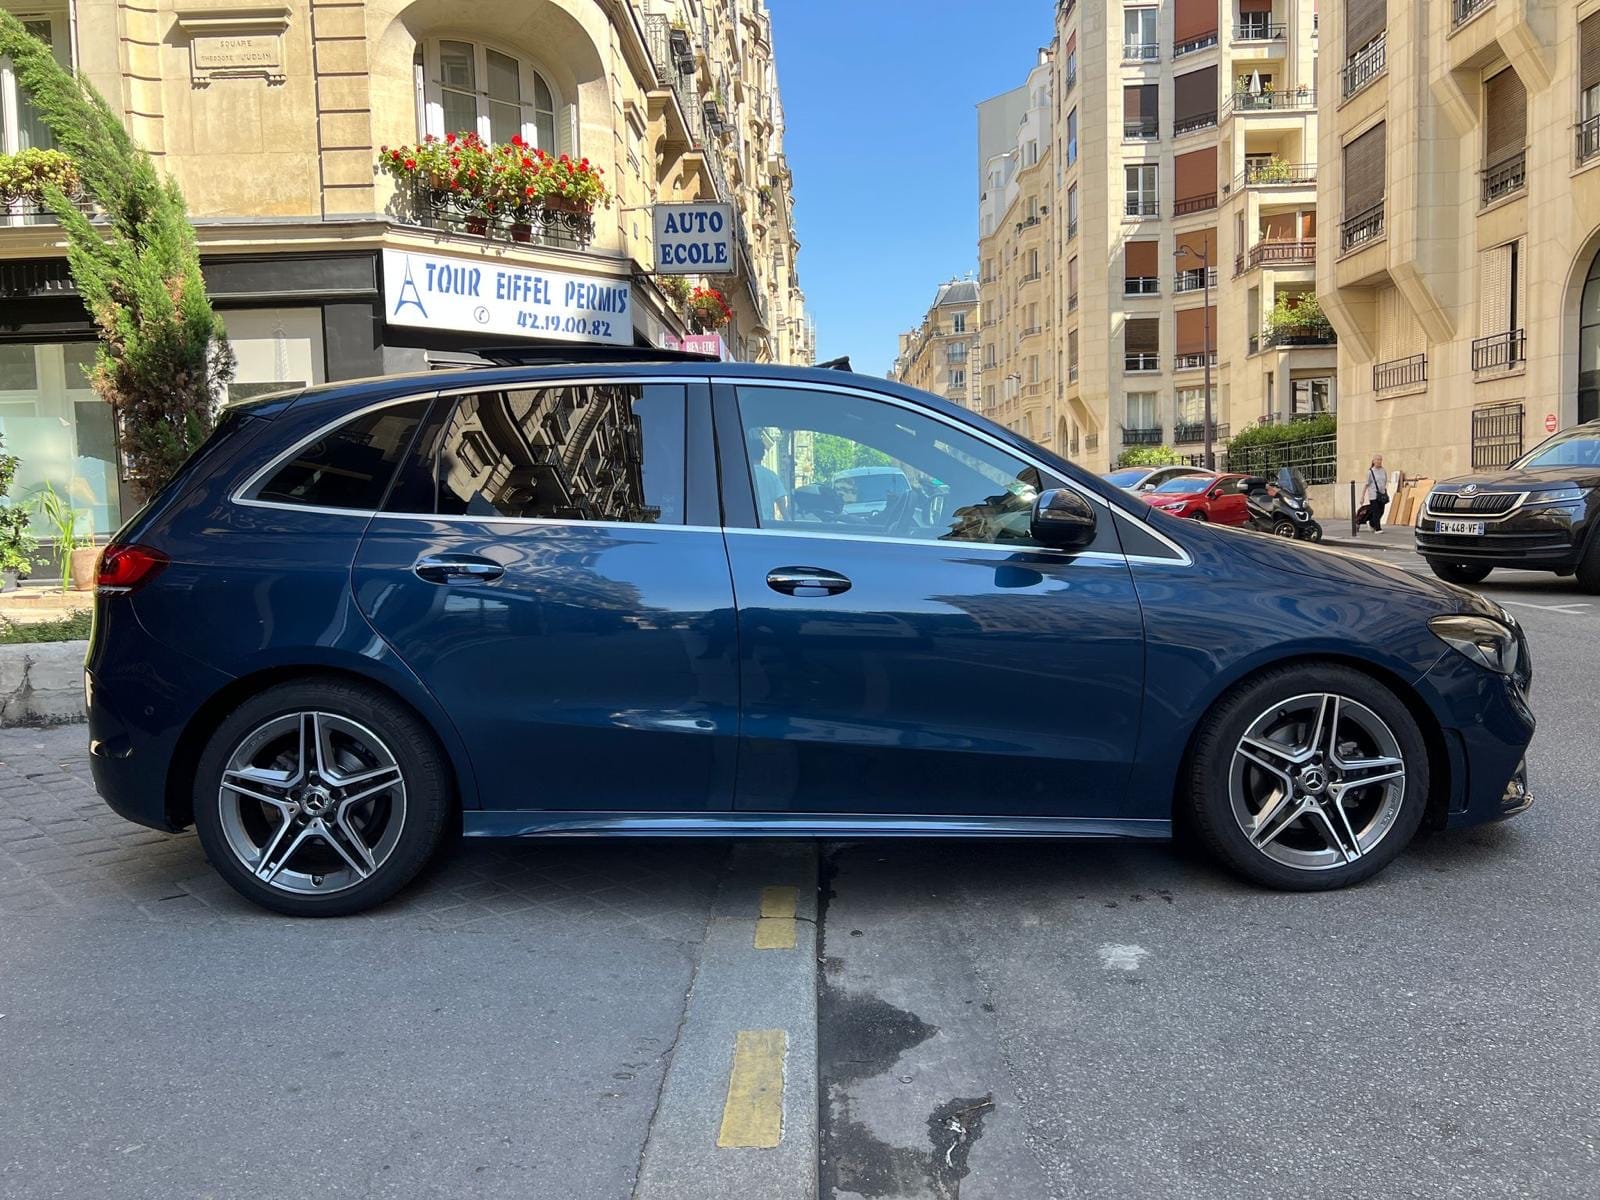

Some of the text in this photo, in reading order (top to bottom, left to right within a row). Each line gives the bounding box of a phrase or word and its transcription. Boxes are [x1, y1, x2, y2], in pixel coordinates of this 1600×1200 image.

[220, 40, 252, 48] SQUARE
[664, 211, 723, 234] AUTO
[660, 241, 728, 265] ECOLE
[425, 263, 628, 314] TOUR EIFFEL PERMIS
[516, 310, 613, 337] 42.19.00.82
